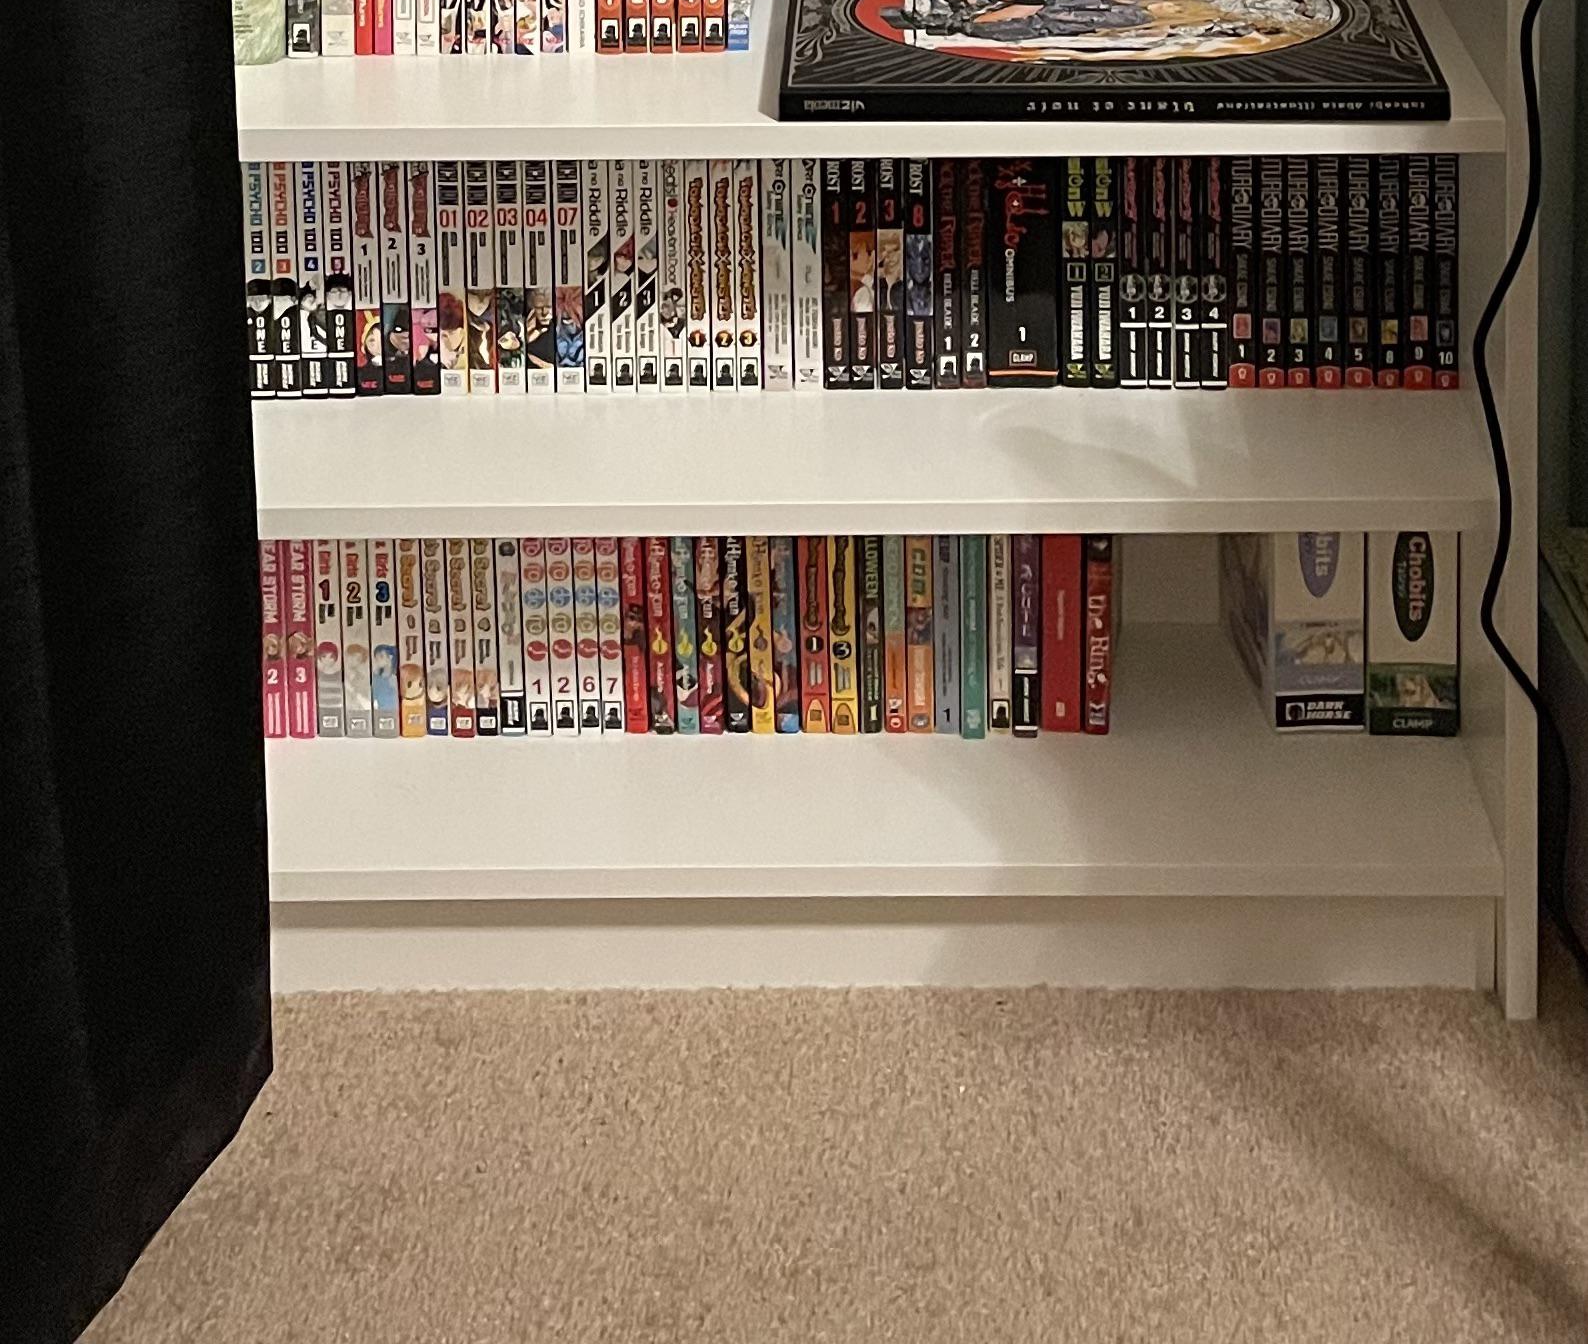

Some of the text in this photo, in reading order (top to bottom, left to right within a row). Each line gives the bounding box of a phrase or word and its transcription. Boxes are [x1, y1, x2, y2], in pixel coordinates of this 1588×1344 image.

[440, 210, 457, 226] 01
[497, 209, 517, 227] 03
[590, 188, 601, 237] Riddle
[1005, 249, 1014, 302] OMNIBUS
[593, 290, 599, 306] 1
[1019, 327, 1026, 341] 1
[1268, 349, 1276, 362] 2
[1409, 537, 1426, 622] Chobits
[347, 582, 361, 603] 2
[607, 678, 616, 693] 7
[1307, 701, 1344, 709] DARK
[1307, 711, 1351, 719] HORSE
[1393, 718, 1432, 729] CLAMP
